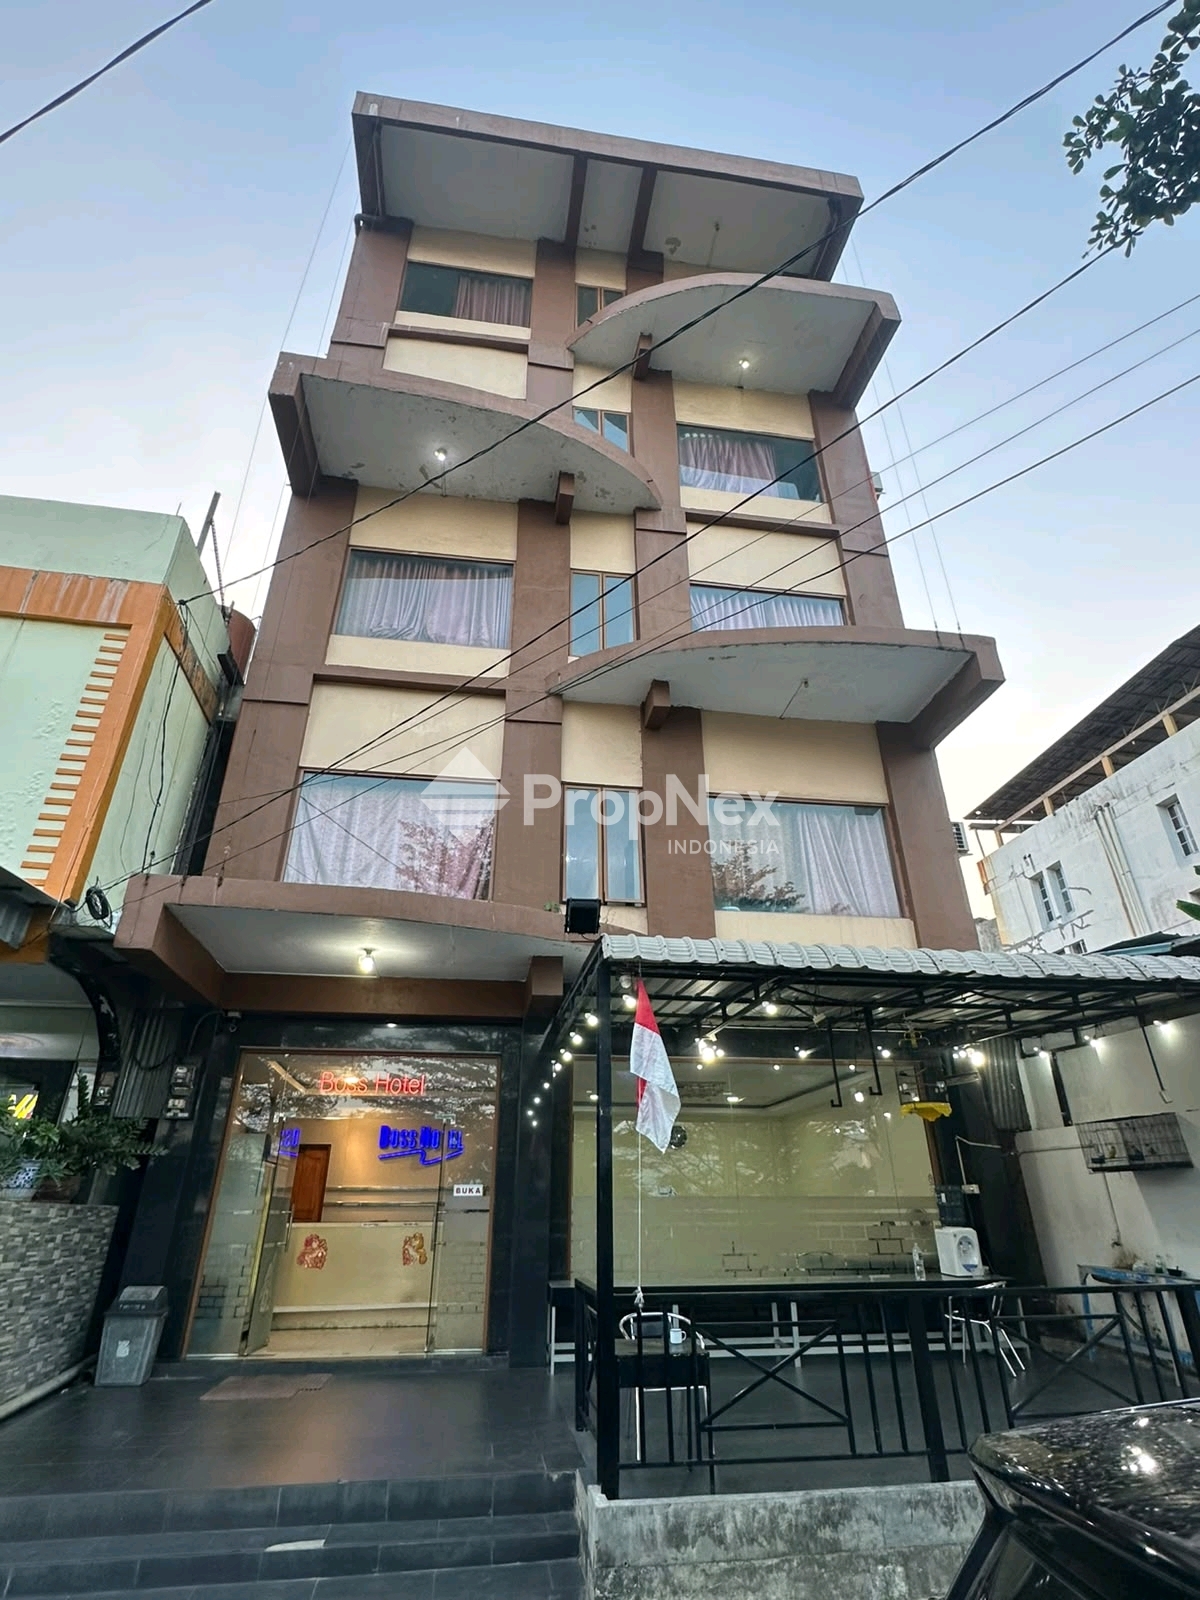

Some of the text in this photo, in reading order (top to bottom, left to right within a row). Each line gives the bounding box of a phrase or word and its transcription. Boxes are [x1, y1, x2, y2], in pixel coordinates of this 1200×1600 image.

[319, 1071, 426, 1096] Boss Hotel
[455, 1186, 482, 1195] BUKA
